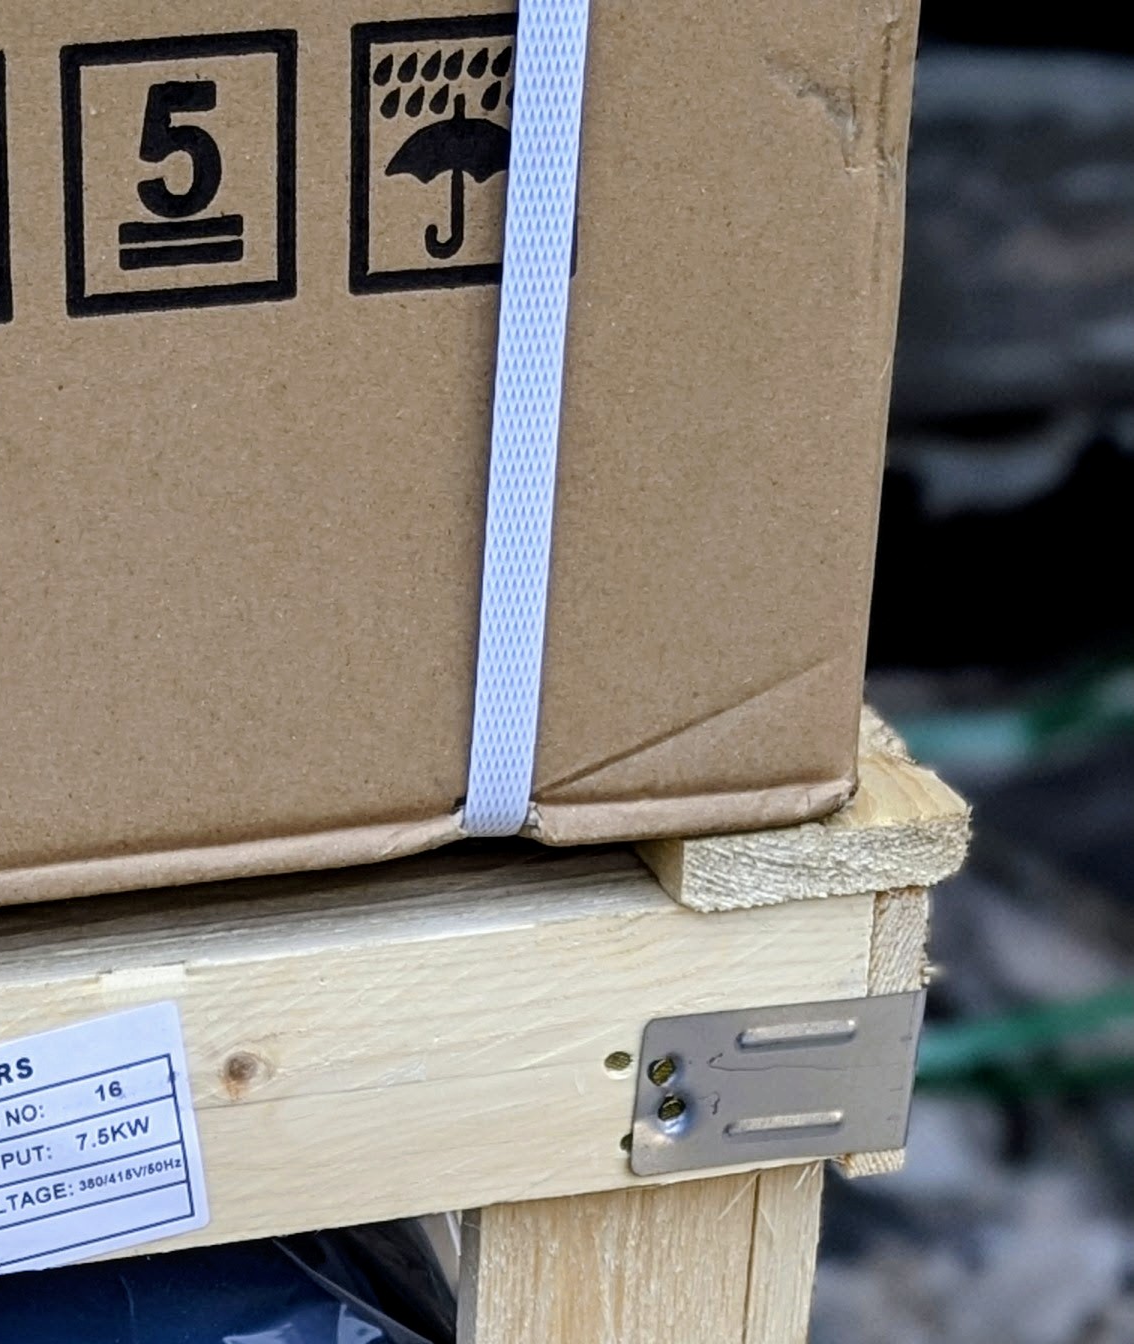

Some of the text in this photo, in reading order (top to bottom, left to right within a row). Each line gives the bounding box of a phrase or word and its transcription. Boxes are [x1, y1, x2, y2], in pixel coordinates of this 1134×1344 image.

[135, 79, 223, 218] 5
[94, 1081, 123, 1101] 16
[5, 1104, 45, 1127] NO:
[75, 1116, 150, 1151] 7.5KW
